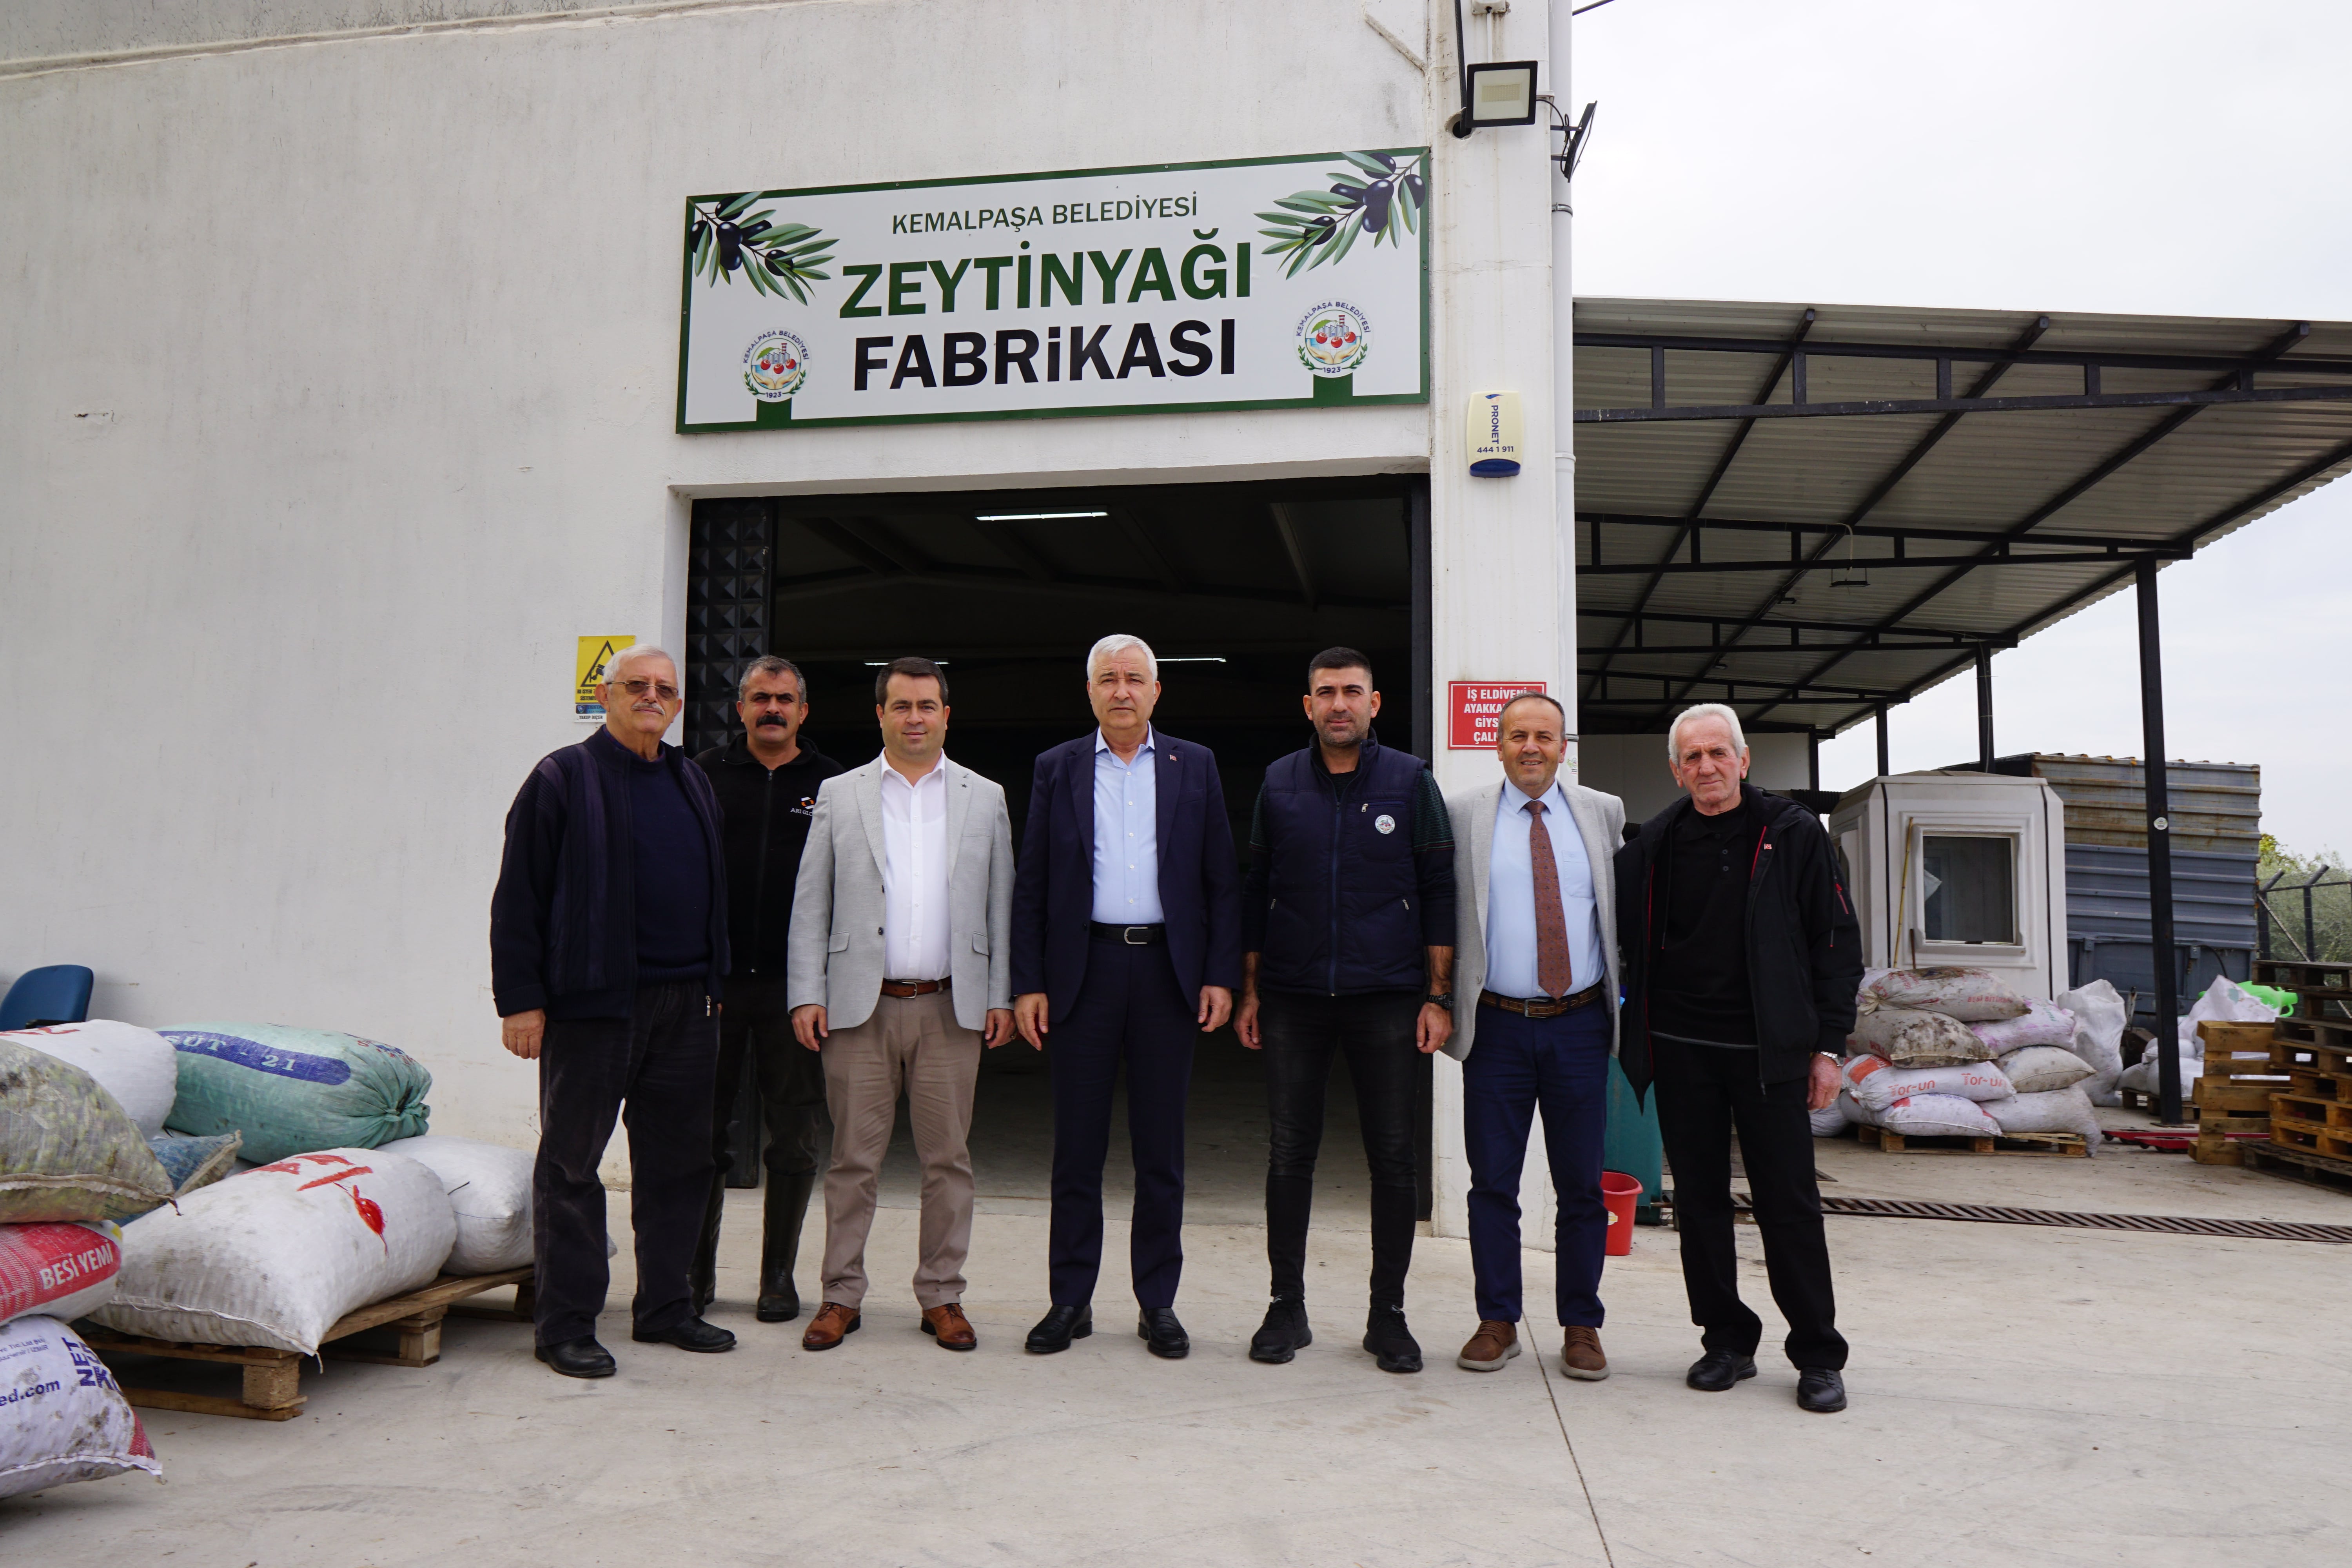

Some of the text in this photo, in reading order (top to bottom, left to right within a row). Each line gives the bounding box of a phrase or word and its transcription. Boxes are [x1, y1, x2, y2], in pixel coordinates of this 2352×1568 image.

[893, 191, 1197, 234] KEMALPAŞA BELEDİYESİ
[839, 228, 1251, 318] ZEYTİNYAĞI
[1296, 301, 1371, 336] KEMALPAŞA BELEDİYESİ
[743, 330, 809, 363] KEMALPAŞA BELEDİYESİ
[1491, 405, 1499, 444] PRONET
[1464, 703, 1506, 713] AYAKKA
[1467, 687, 1477, 701] İŞ
[261, 1055, 296, 1071] 21
[40, 1239, 113, 1290] BESİ YEMİ
[61, 1337, 96, 1386] NET
